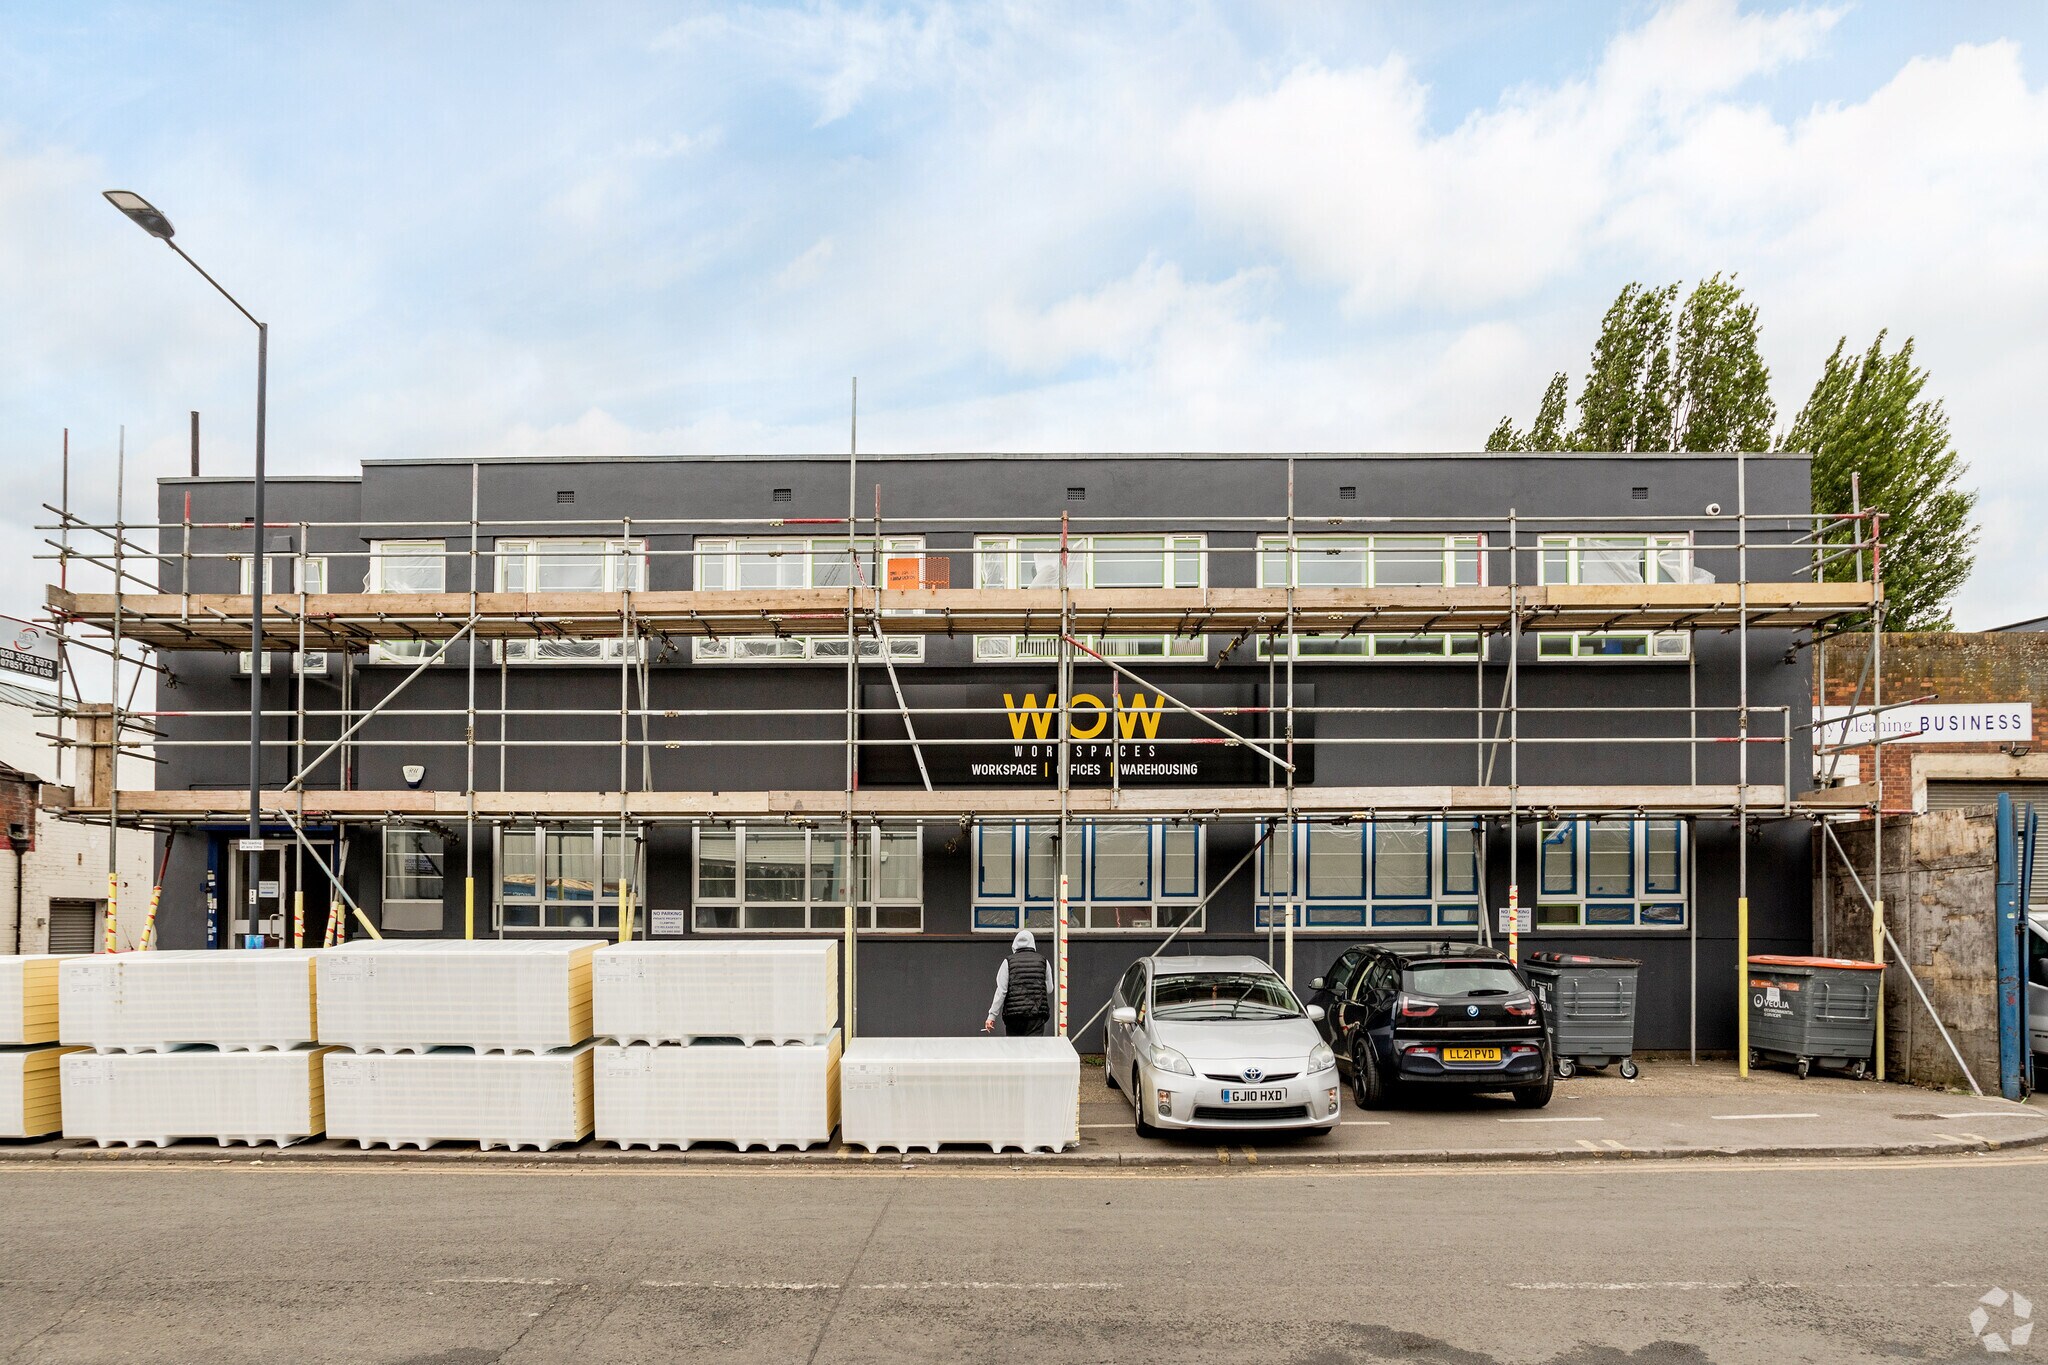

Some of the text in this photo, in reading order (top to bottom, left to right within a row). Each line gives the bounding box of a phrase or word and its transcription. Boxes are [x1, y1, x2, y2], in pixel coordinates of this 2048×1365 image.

[0, 649, 14, 659] 020
[15, 653, 34, 664] 3556
[0, 658, 53, 677] 07851 270 030
[1003, 693, 1165, 739] WOW
[1920, 714, 2021, 731] BUSINESS
[1014, 745, 1155, 757] WORSPACES
[971, 763, 1198, 776] WORKSPACE FICES WAREHOUSING
[1764, 1000, 1789, 1008] VEOLIA
[1449, 1049, 1495, 1059] LL21 PVD
[1232, 1090, 1282, 1101] GJ10 HXD
